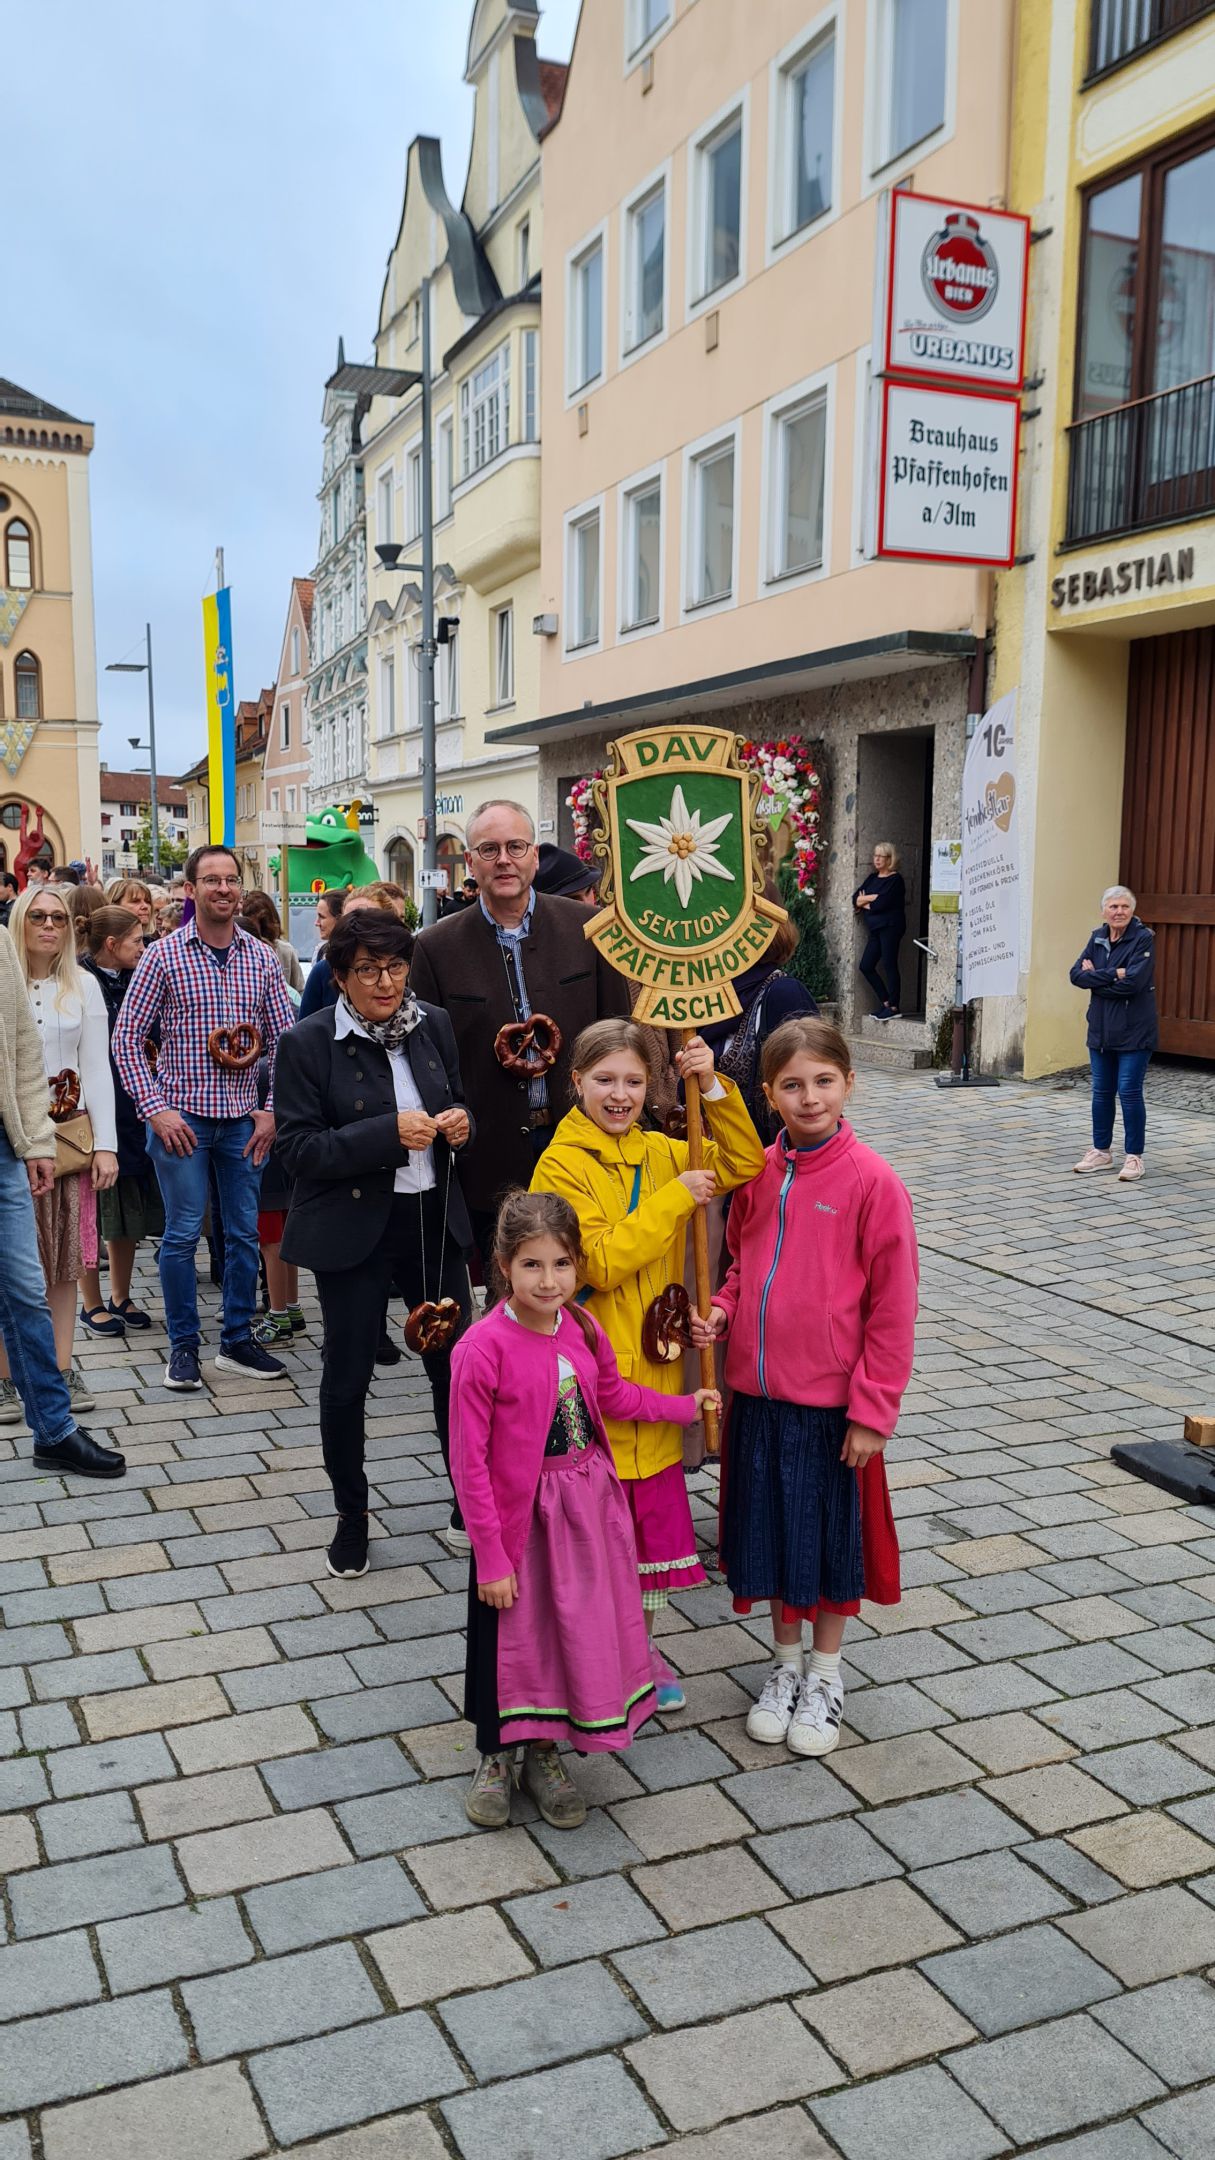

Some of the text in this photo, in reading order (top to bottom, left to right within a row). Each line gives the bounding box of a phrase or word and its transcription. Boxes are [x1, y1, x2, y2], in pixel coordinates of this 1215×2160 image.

[926, 253, 996, 289] Urbanus
[944, 285, 974, 304] BIER
[909, 332, 1014, 370] URBANUS
[909, 419, 999, 454] Brauhaus
[892, 455, 1008, 493] Pfaffenhofen
[922, 500, 976, 528] a/Ilm
[1050, 546, 1194, 608] SEBASTIAN
[635, 735, 718, 767] DAV
[435, 790, 464, 815] elmann
[638, 905, 731, 941] SEKTION
[982, 924, 997, 935] FASS
[598, 912, 776, 987] PFAFFENHOFEN
[993, 941, 1006, 951] UND
[650, 992, 726, 1022] ASCH
